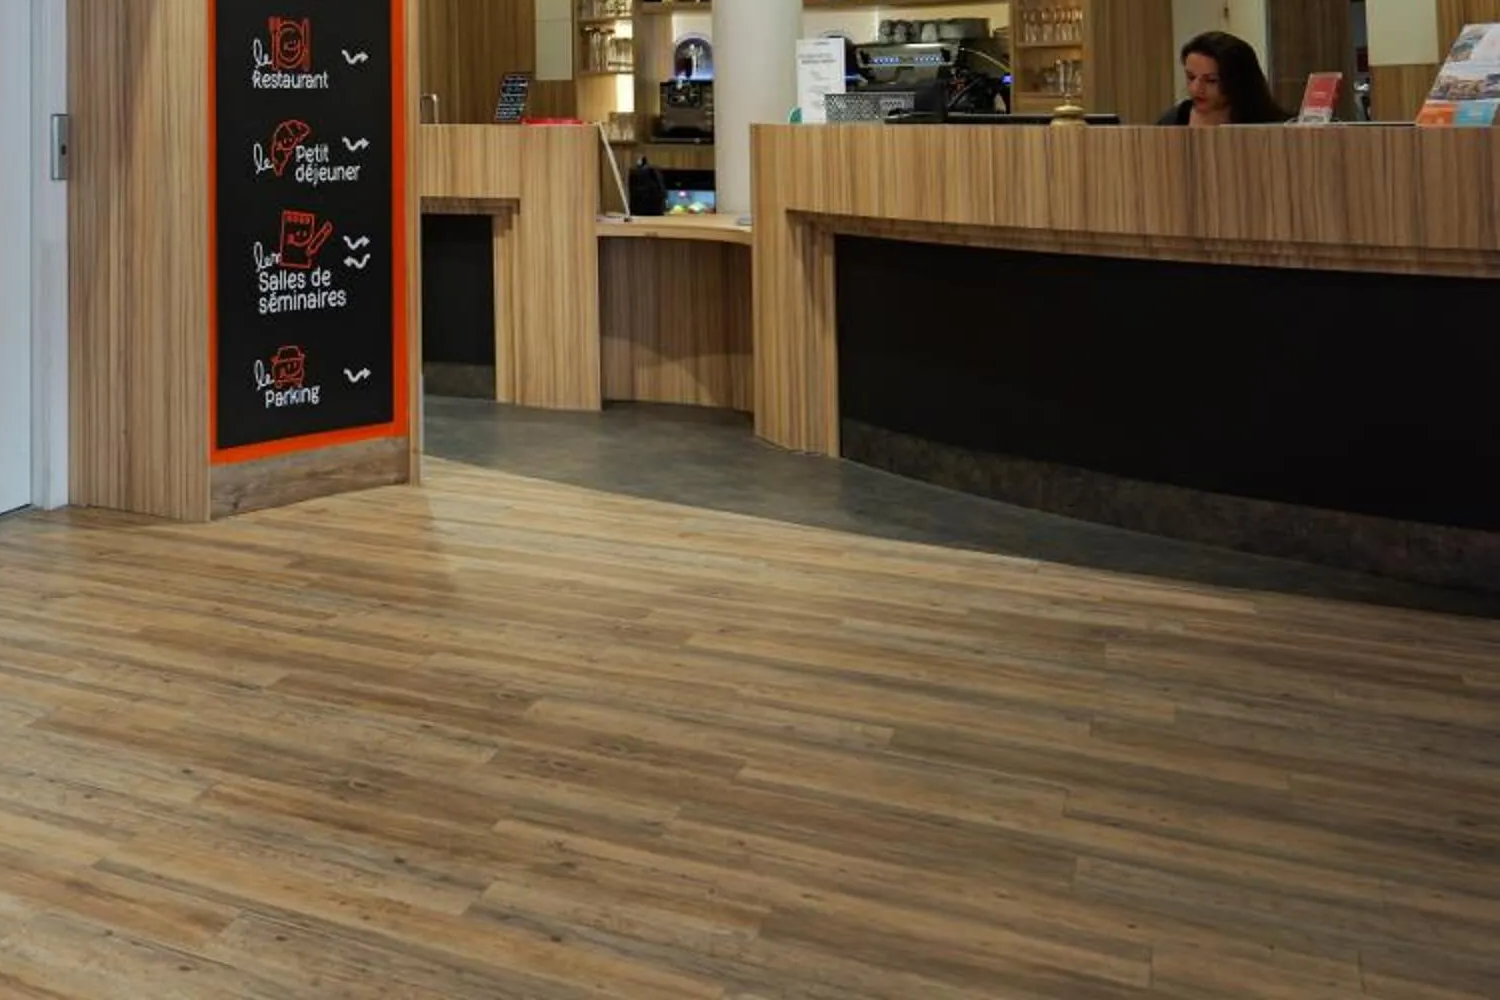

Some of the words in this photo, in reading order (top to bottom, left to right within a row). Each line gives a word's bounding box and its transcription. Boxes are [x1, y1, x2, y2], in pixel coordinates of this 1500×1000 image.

[253, 37, 272, 69] le
[252, 69, 329, 89] Restaurant
[253, 143, 274, 174] le
[295, 143, 329, 163] Petit
[295, 164, 361, 188] déjeuner
[259, 268, 306, 292] Salles
[311, 266, 332, 287] de
[259, 288, 347, 315] séminaires
[254, 359, 275, 390] le
[265, 385, 321, 408] Parking
